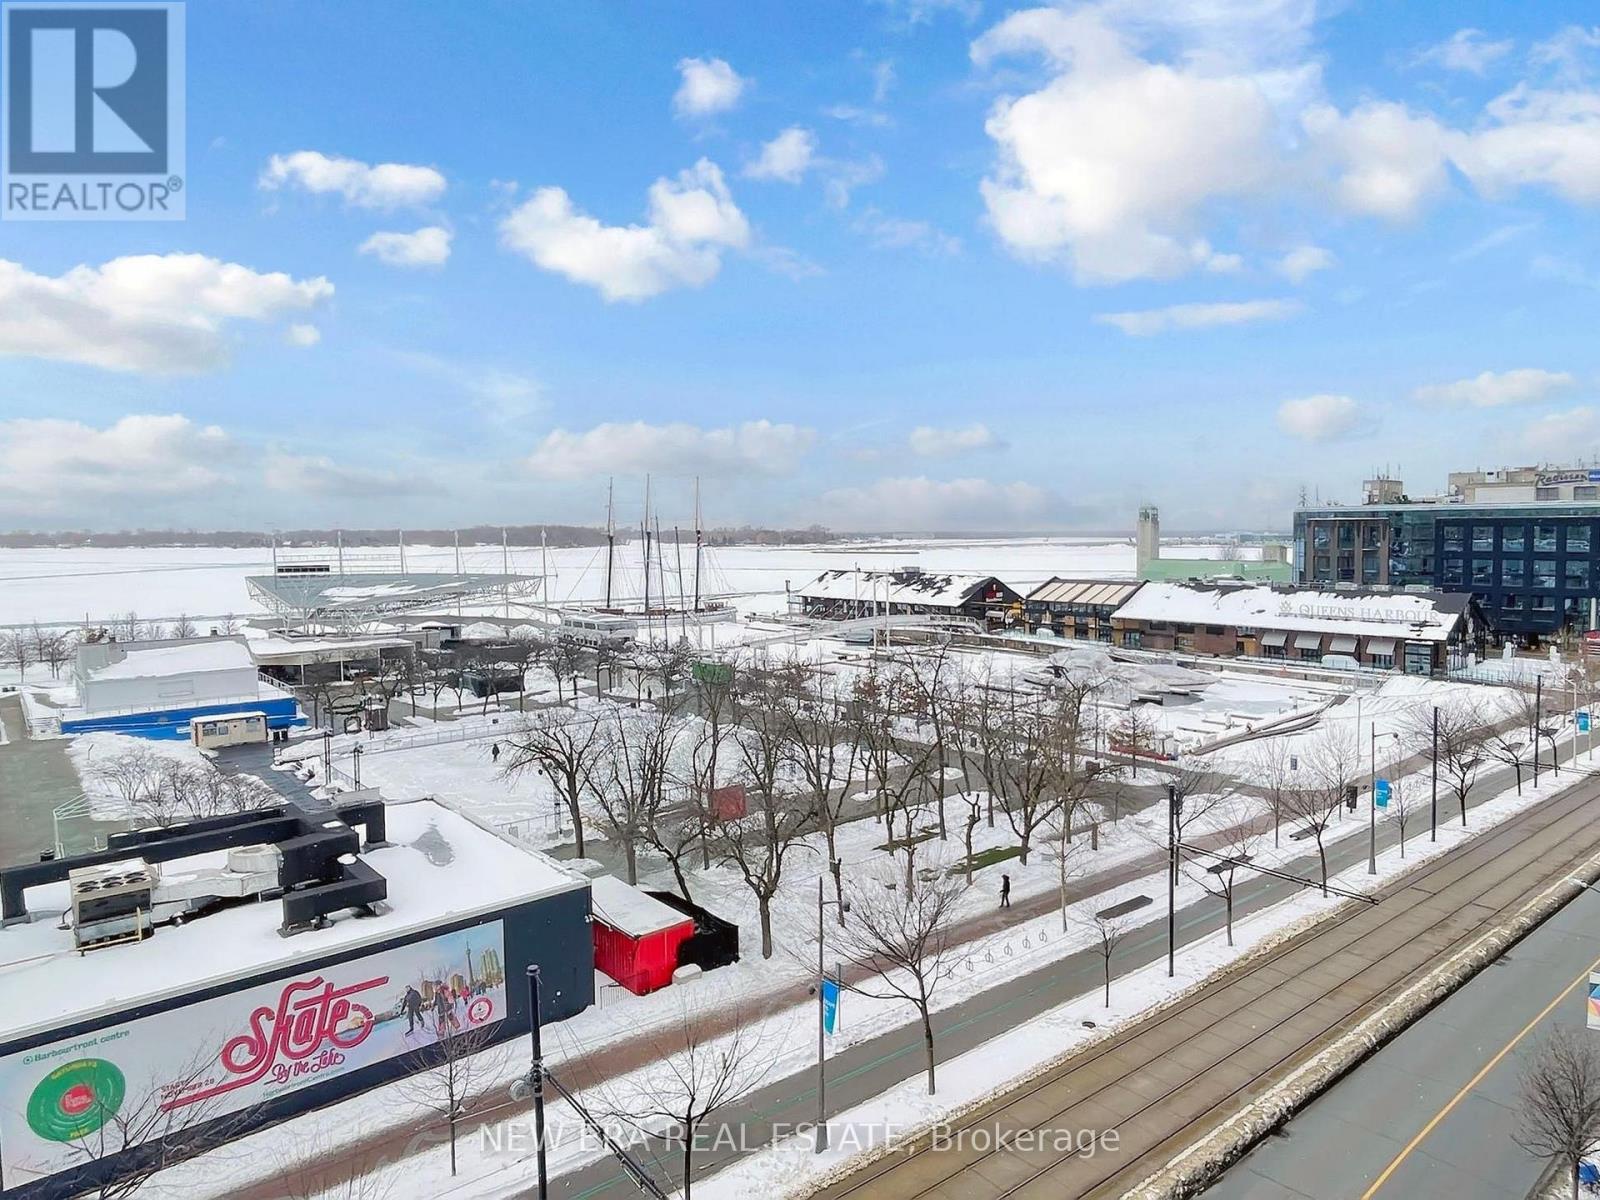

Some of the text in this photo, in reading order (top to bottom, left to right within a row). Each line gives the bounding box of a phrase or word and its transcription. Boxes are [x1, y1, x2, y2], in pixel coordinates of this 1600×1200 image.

[1299, 603, 1439, 622] QUEENS HARBOUR
[195, 976, 390, 1090] Skate
[311, 1047, 346, 1073] Lake
